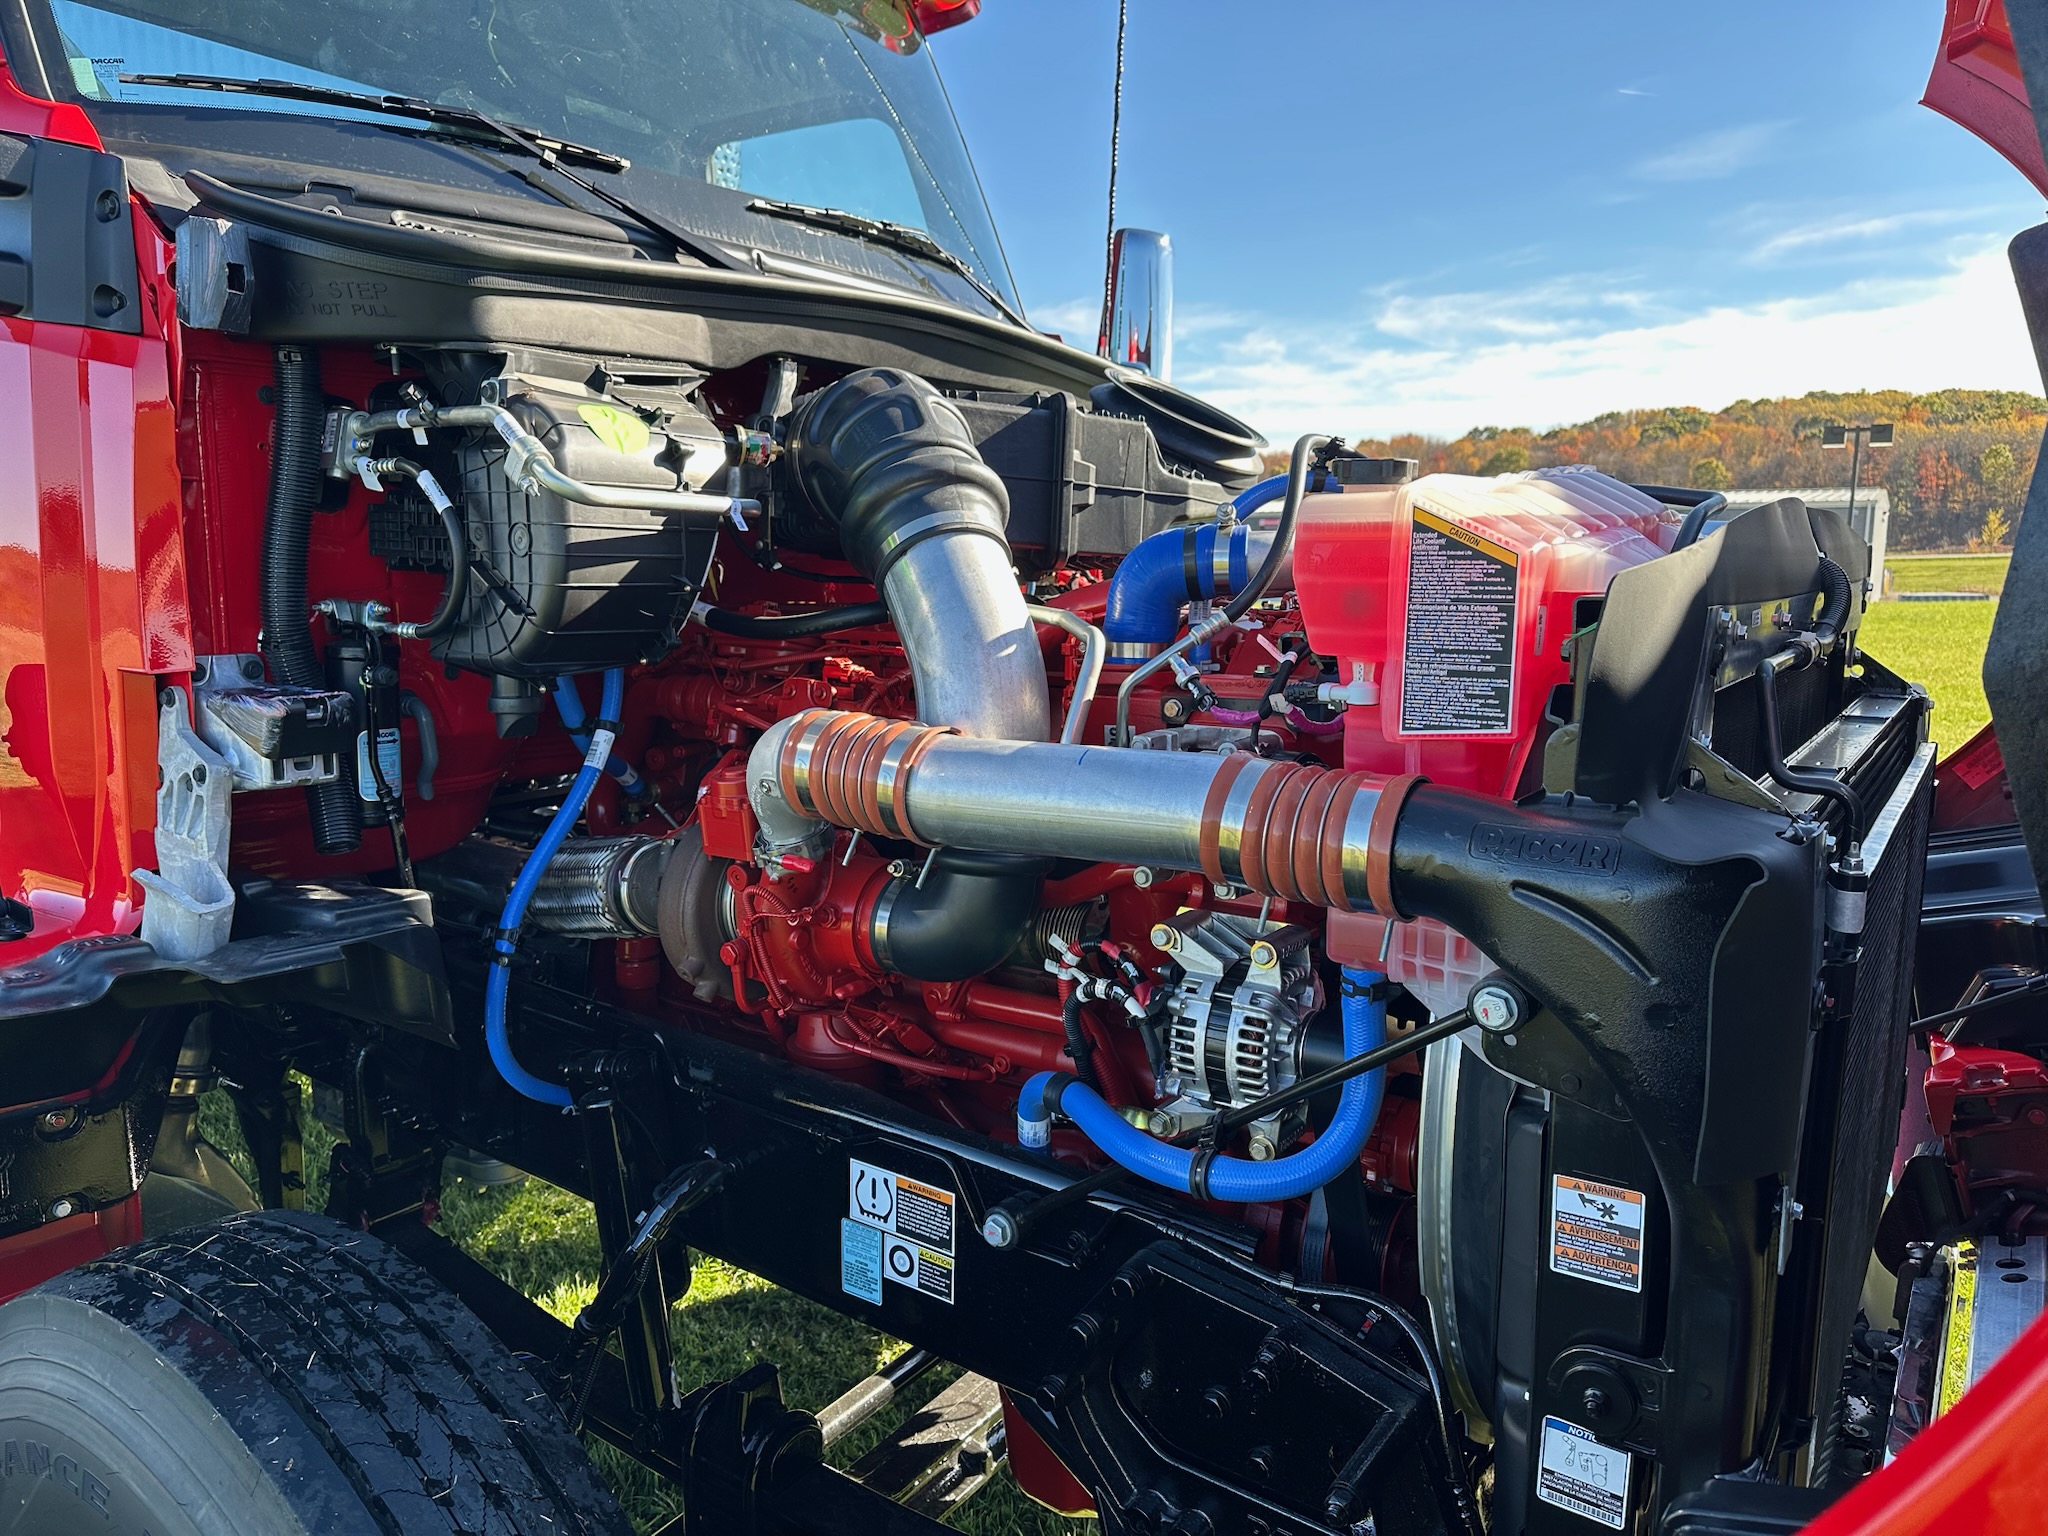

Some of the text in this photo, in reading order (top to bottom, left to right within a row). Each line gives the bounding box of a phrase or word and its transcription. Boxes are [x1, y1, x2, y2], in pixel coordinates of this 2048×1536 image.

[328, 280, 388, 300] STEP
[312, 303, 341, 316] NOT
[351, 303, 398, 318] PULL
[1448, 527, 1481, 547] CAUTION
[1478, 828, 1610, 869] PACCAR
[912, 1184, 941, 1199] WARNING
[1584, 1184, 1625, 1200] WARNING
[1569, 1226, 1639, 1249] AVERTISSEMENT
[925, 1252, 951, 1267] CAUTION
[1572, 1251, 1633, 1273] ADVERTENCIA
[0, 1439, 110, 1520] ANCE
